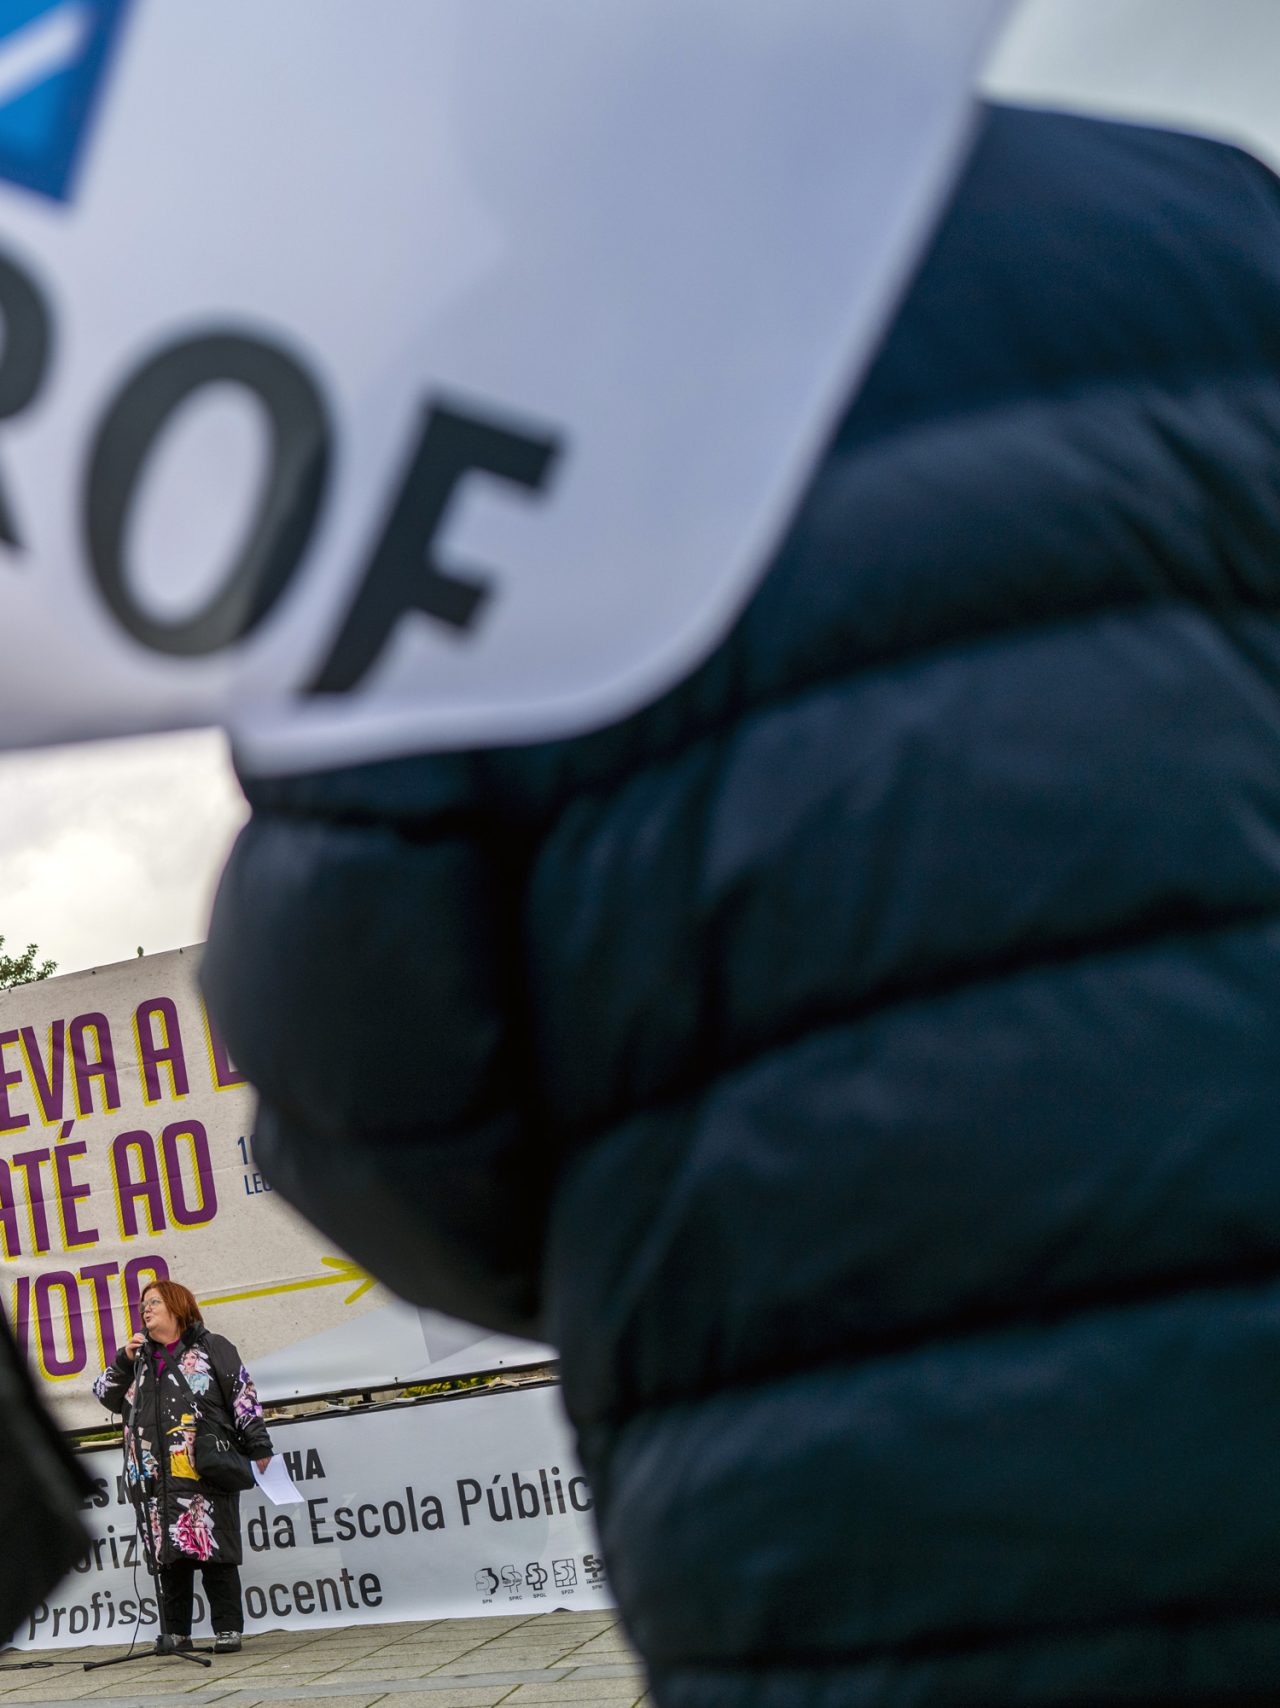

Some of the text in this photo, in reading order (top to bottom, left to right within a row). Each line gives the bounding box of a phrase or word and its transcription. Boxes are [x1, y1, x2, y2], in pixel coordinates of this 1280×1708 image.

[133, 996, 189, 1106] A
[111, 1119, 218, 1238] AO
[247, 1466, 594, 1552] da Escola Públic
[28, 1568, 384, 1641] Profisso ocente
